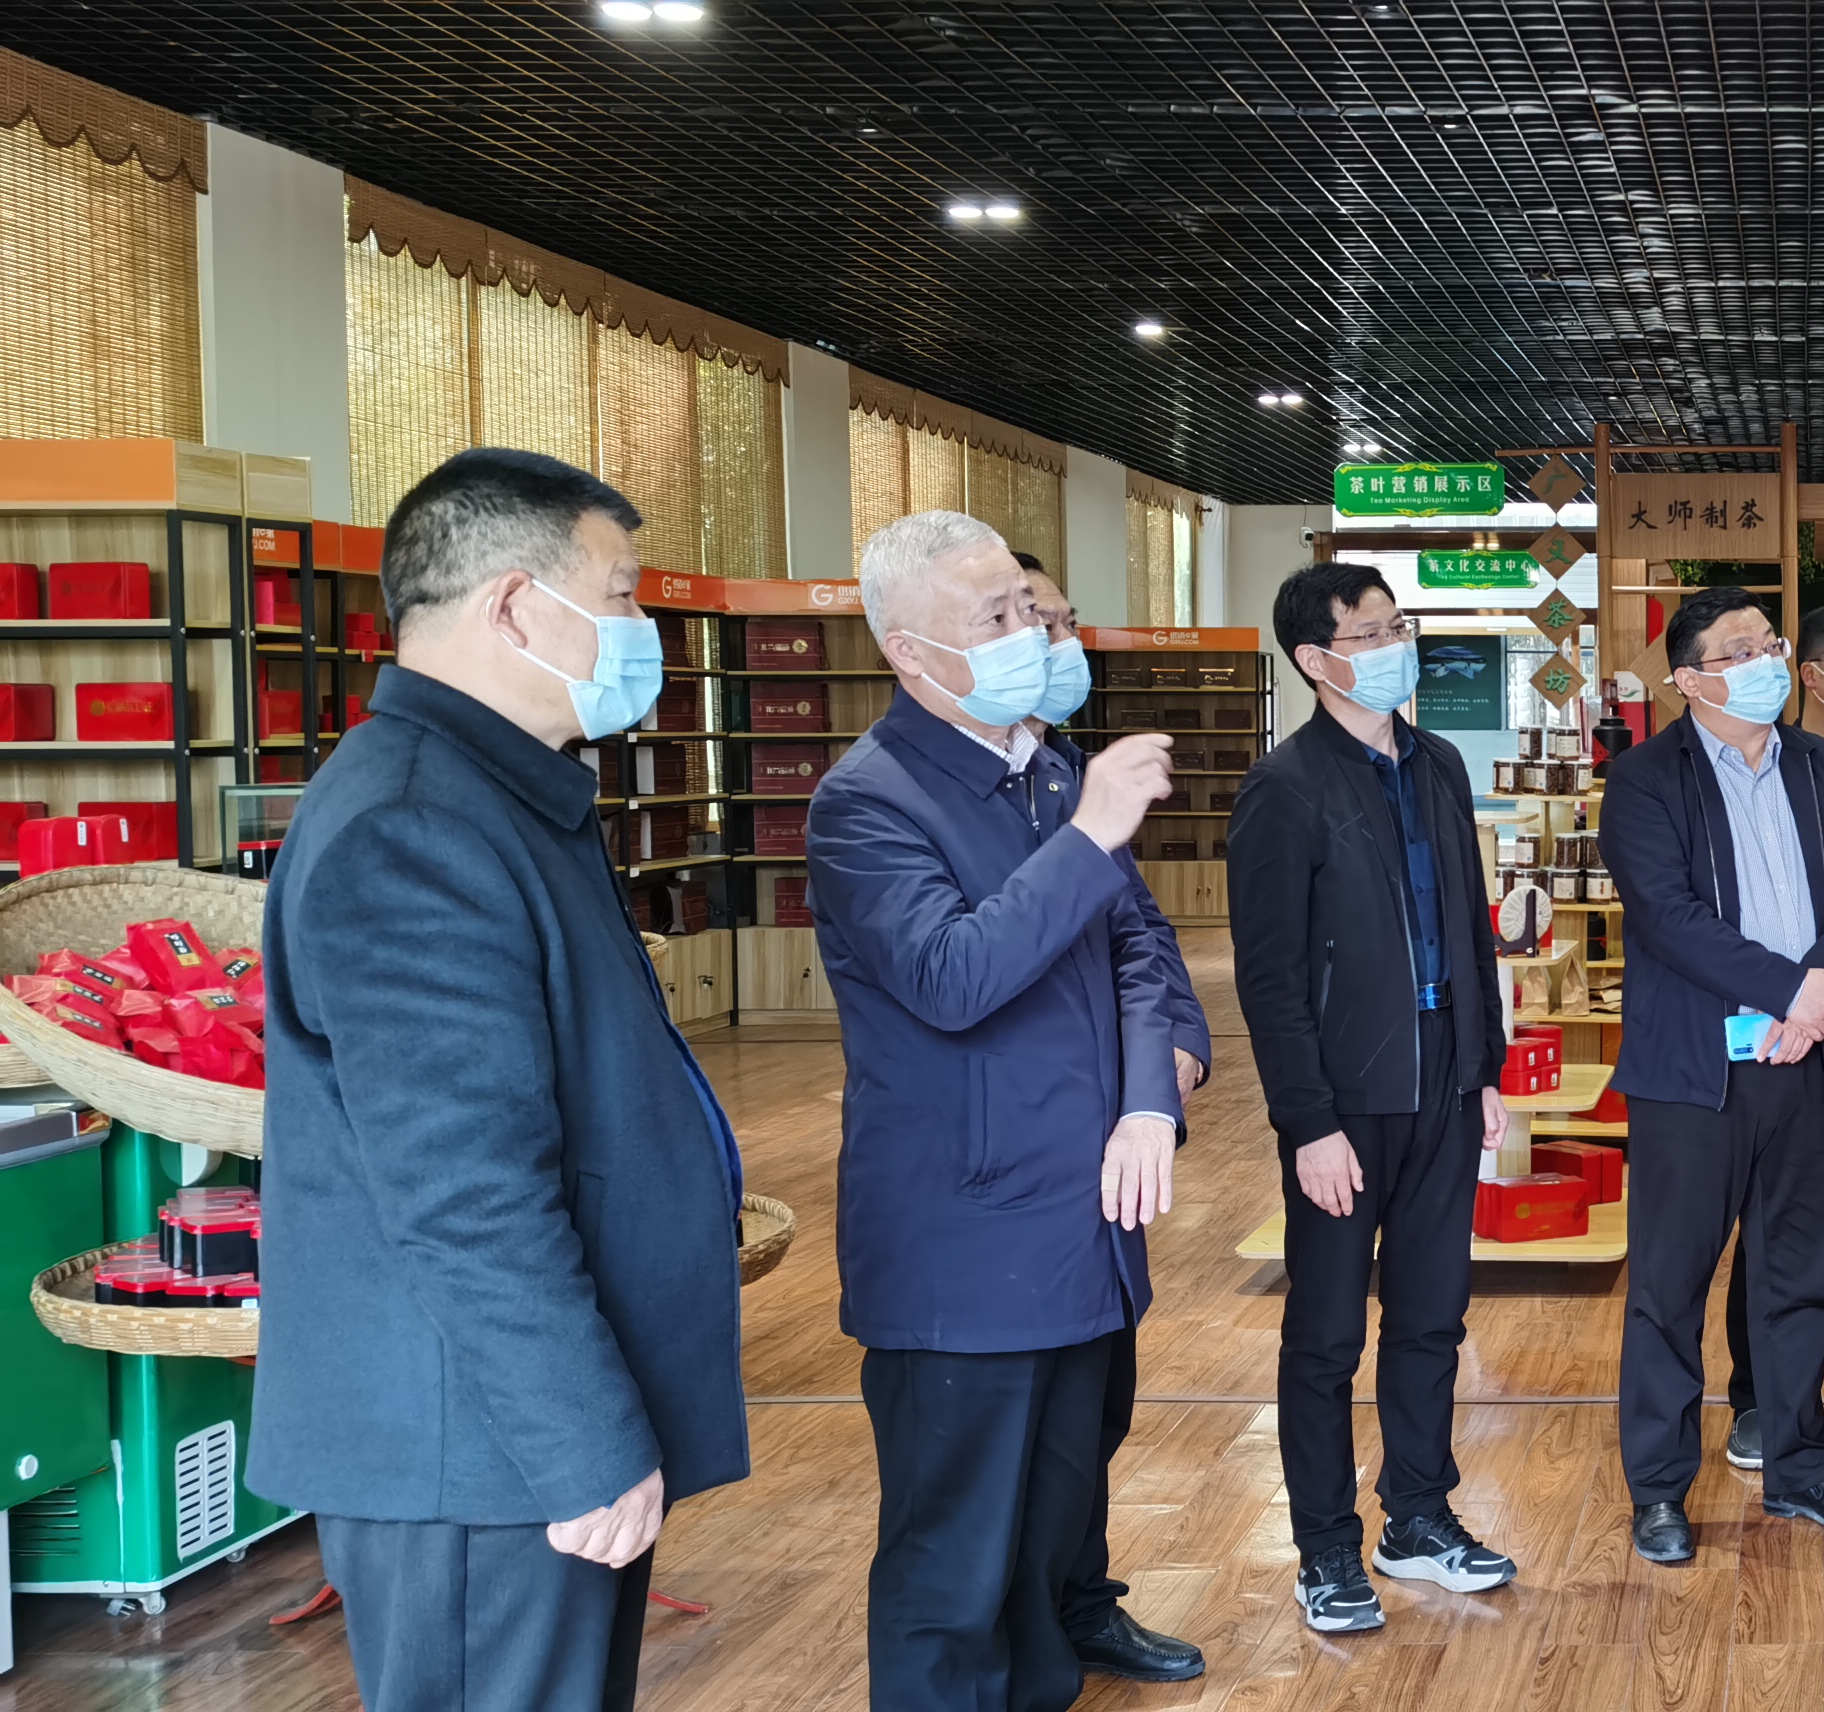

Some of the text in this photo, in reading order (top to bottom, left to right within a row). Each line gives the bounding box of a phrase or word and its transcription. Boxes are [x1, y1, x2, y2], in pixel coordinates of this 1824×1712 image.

[1349, 476, 1492, 494] 茶叶营销展示区
[1384, 496, 1422, 505] Marketing
[1423, 496, 1451, 504] Display
[1628, 498, 1765, 531] 大师制茶
[1428, 558, 1530, 572] 茶文化交流中心
